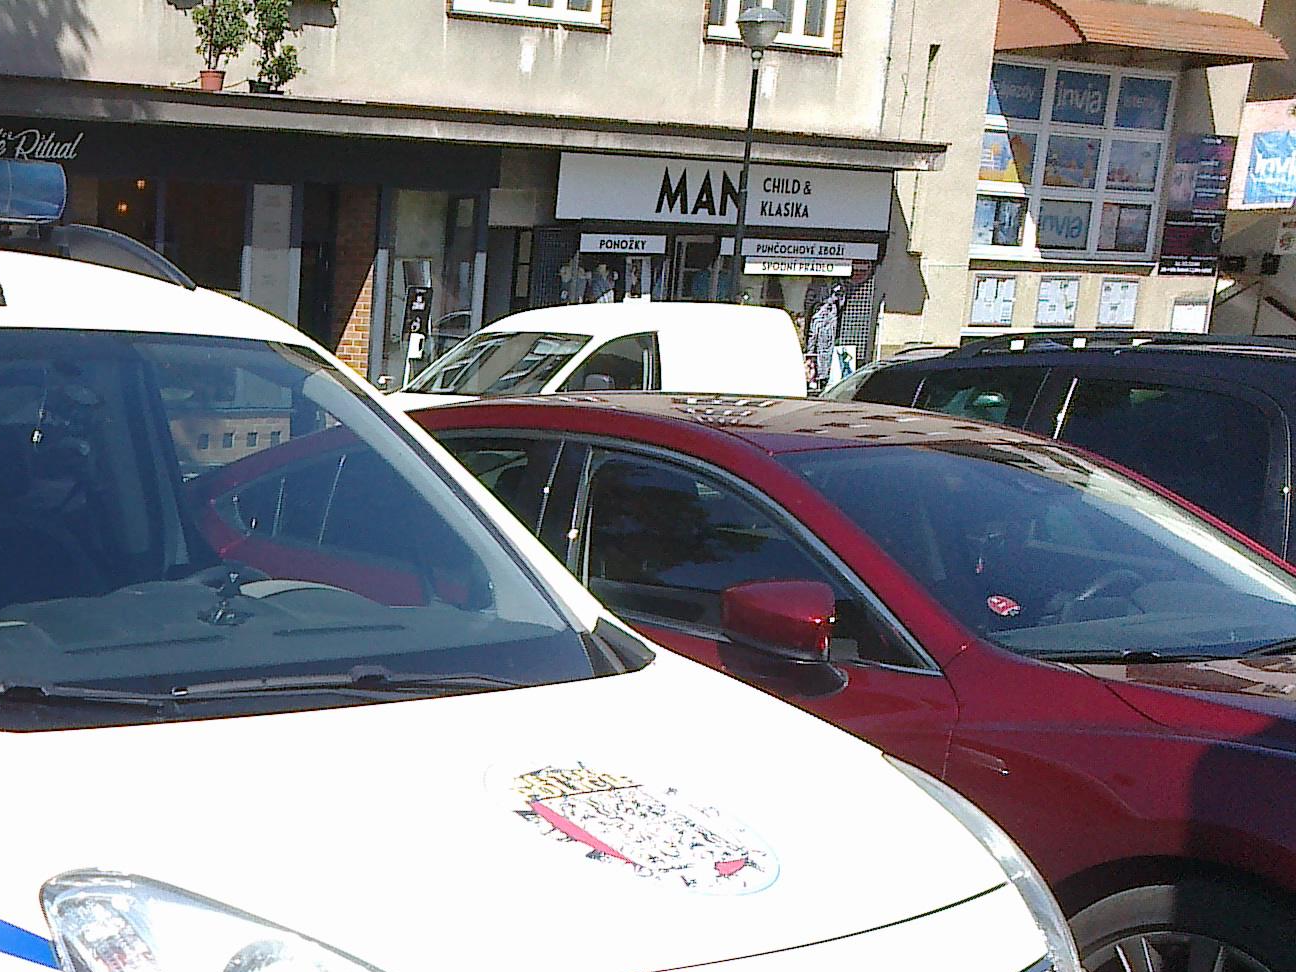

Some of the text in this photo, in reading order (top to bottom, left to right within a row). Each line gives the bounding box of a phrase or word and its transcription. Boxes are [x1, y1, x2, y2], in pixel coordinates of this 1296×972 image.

[1055, 80, 1104, 115] invia
[11, 129, 85, 160] Ritual
[655, 166, 812, 217] MAN CHILD &
[760, 200, 810, 218] KLASIKA
[599, 236, 647, 250] PONOŽKY
